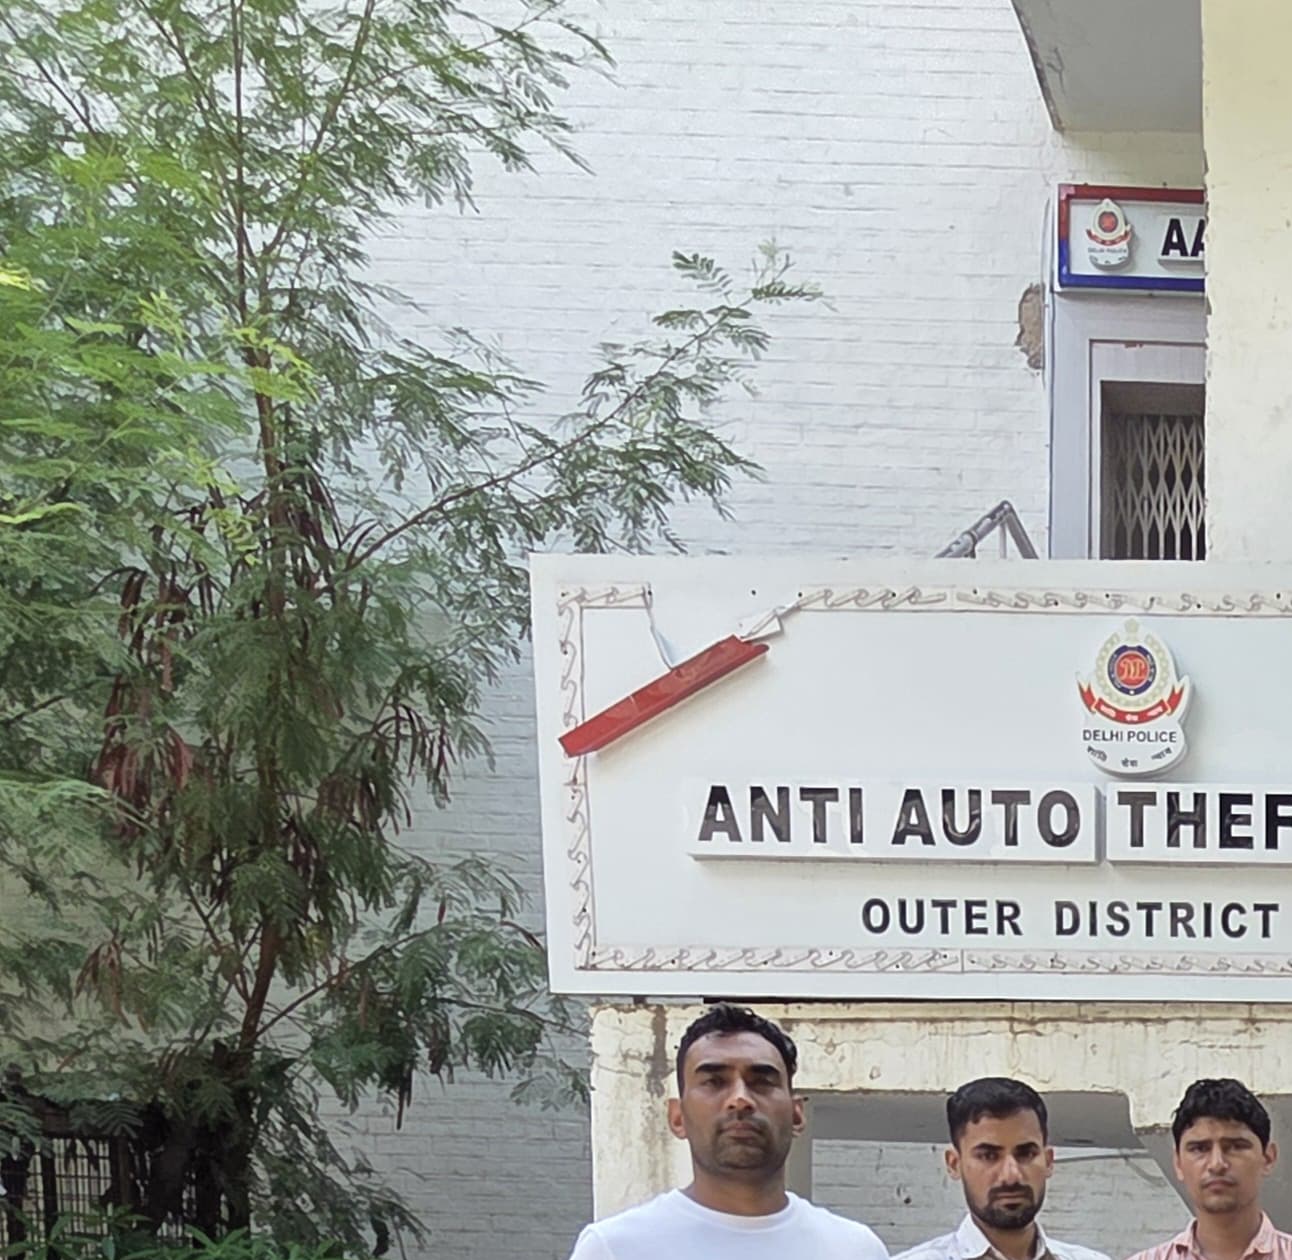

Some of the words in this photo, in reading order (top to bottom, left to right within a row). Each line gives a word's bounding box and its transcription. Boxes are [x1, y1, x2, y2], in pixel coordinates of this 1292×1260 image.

[1082, 729, 1123, 742] DELHI
[1127, 731, 1177, 743] POLICE
[699, 785, 863, 844] ANTI
[891, 788, 1080, 848] AUTO
[862, 898, 1023, 936] OUTER
[1054, 900, 1279, 939] DISTRICT
